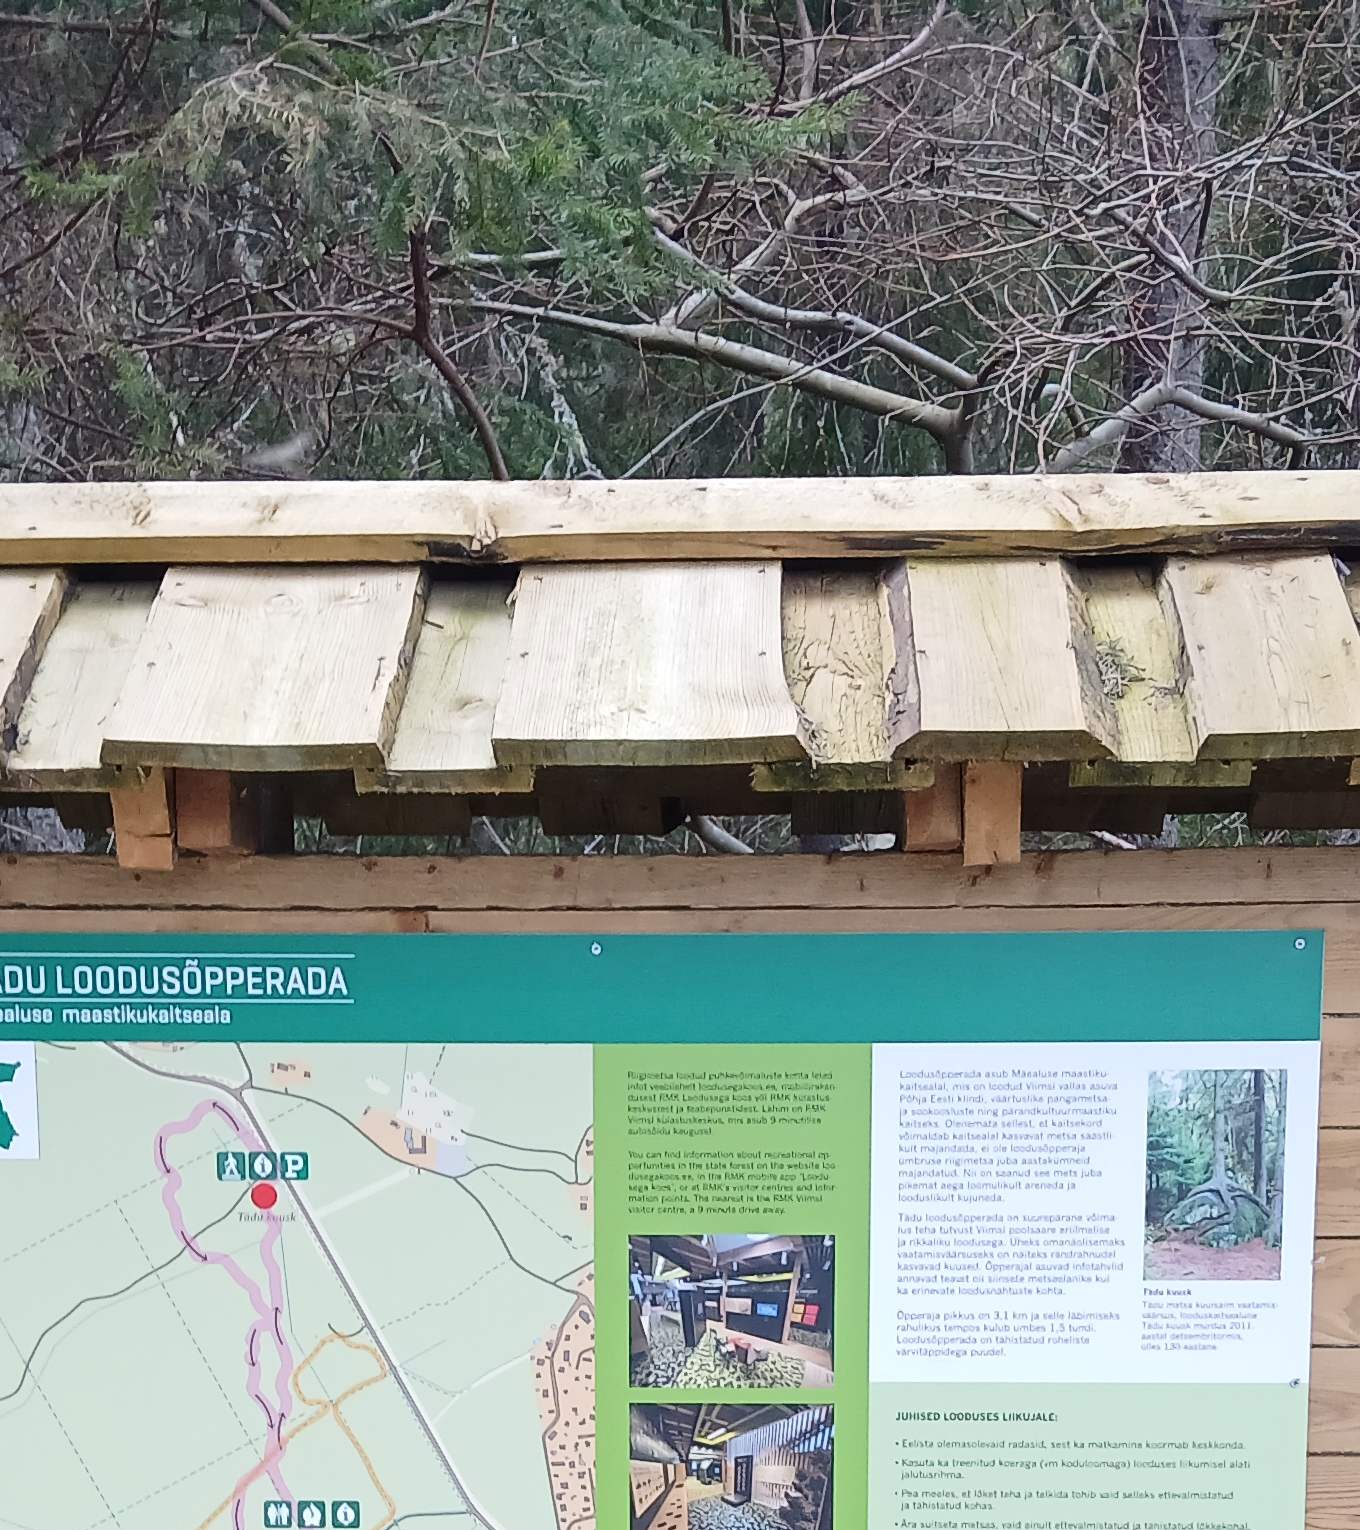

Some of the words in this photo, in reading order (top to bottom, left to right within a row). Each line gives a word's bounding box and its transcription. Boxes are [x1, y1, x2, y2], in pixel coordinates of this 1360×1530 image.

[56, 959, 349, 997] LOODUSÕPPERADA
[62, 1004, 231, 1025] maastikukaitseala
[895, 1411, 940, 1422] JUHISED
[943, 1412, 999, 1422] LOODUSES
[1002, 1412, 1059, 1422] LIIKUJALE:
